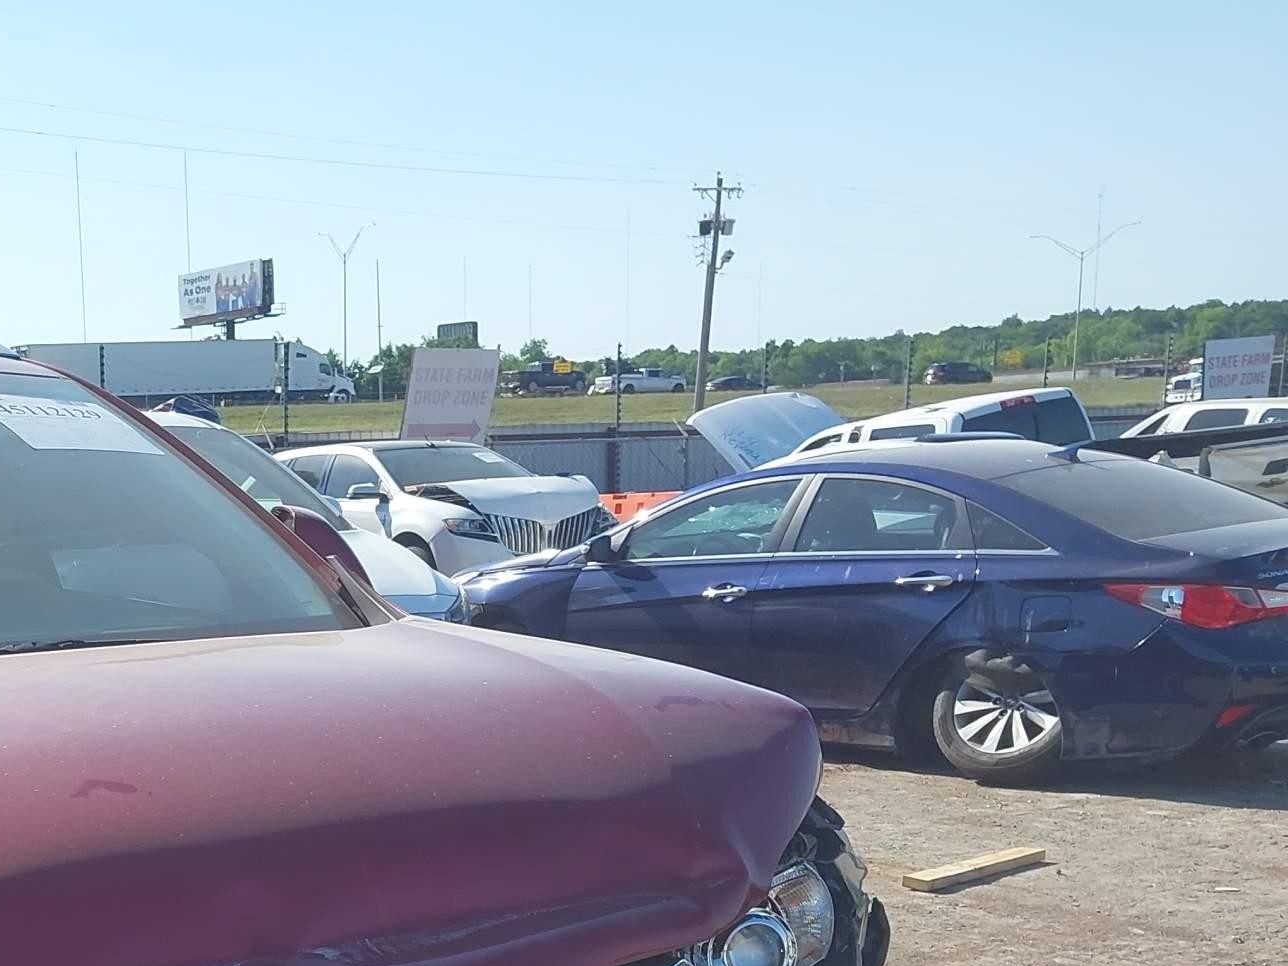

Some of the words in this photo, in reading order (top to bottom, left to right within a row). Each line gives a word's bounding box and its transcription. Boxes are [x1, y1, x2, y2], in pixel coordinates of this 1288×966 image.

[195, 285, 211, 296] One
[1207, 354, 1239, 370] STATE
[1241, 352, 1271, 367] FARM
[415, 367, 451, 384] STATE
[455, 367, 495, 384] FARM
[1209, 373, 1238, 389] DROP
[1240, 370, 1267, 386] ZONE
[414, 390, 450, 406] DROP
[453, 390, 489, 406] ZONE
